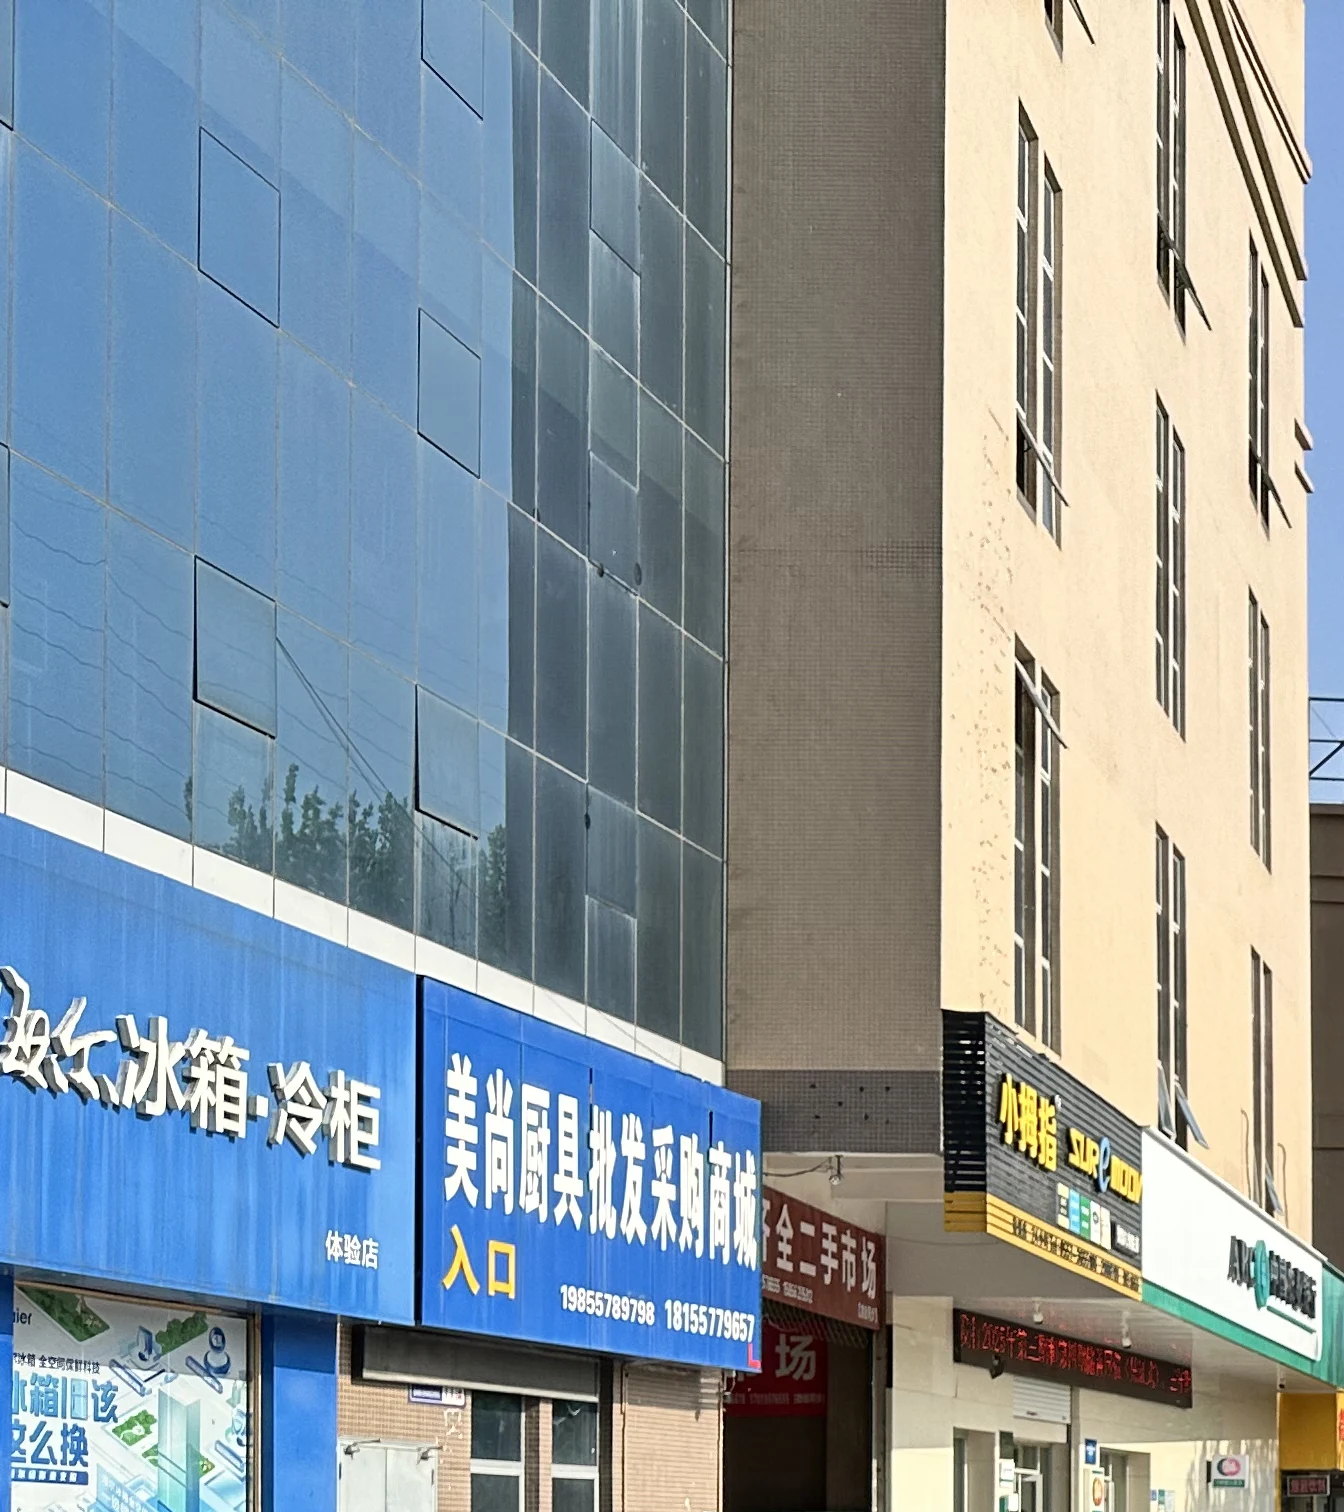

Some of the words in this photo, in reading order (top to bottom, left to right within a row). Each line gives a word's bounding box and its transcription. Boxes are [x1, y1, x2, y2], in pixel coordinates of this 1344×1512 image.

[445, 1052, 758, 1272] 美尚厨具批发采购商城
[325, 1229, 380, 1270] 体验店
[442, 1224, 517, 1300] 入口
[560, 1284, 656, 1326] 19855789798
[664, 1298, 756, 1343] 18155779657
